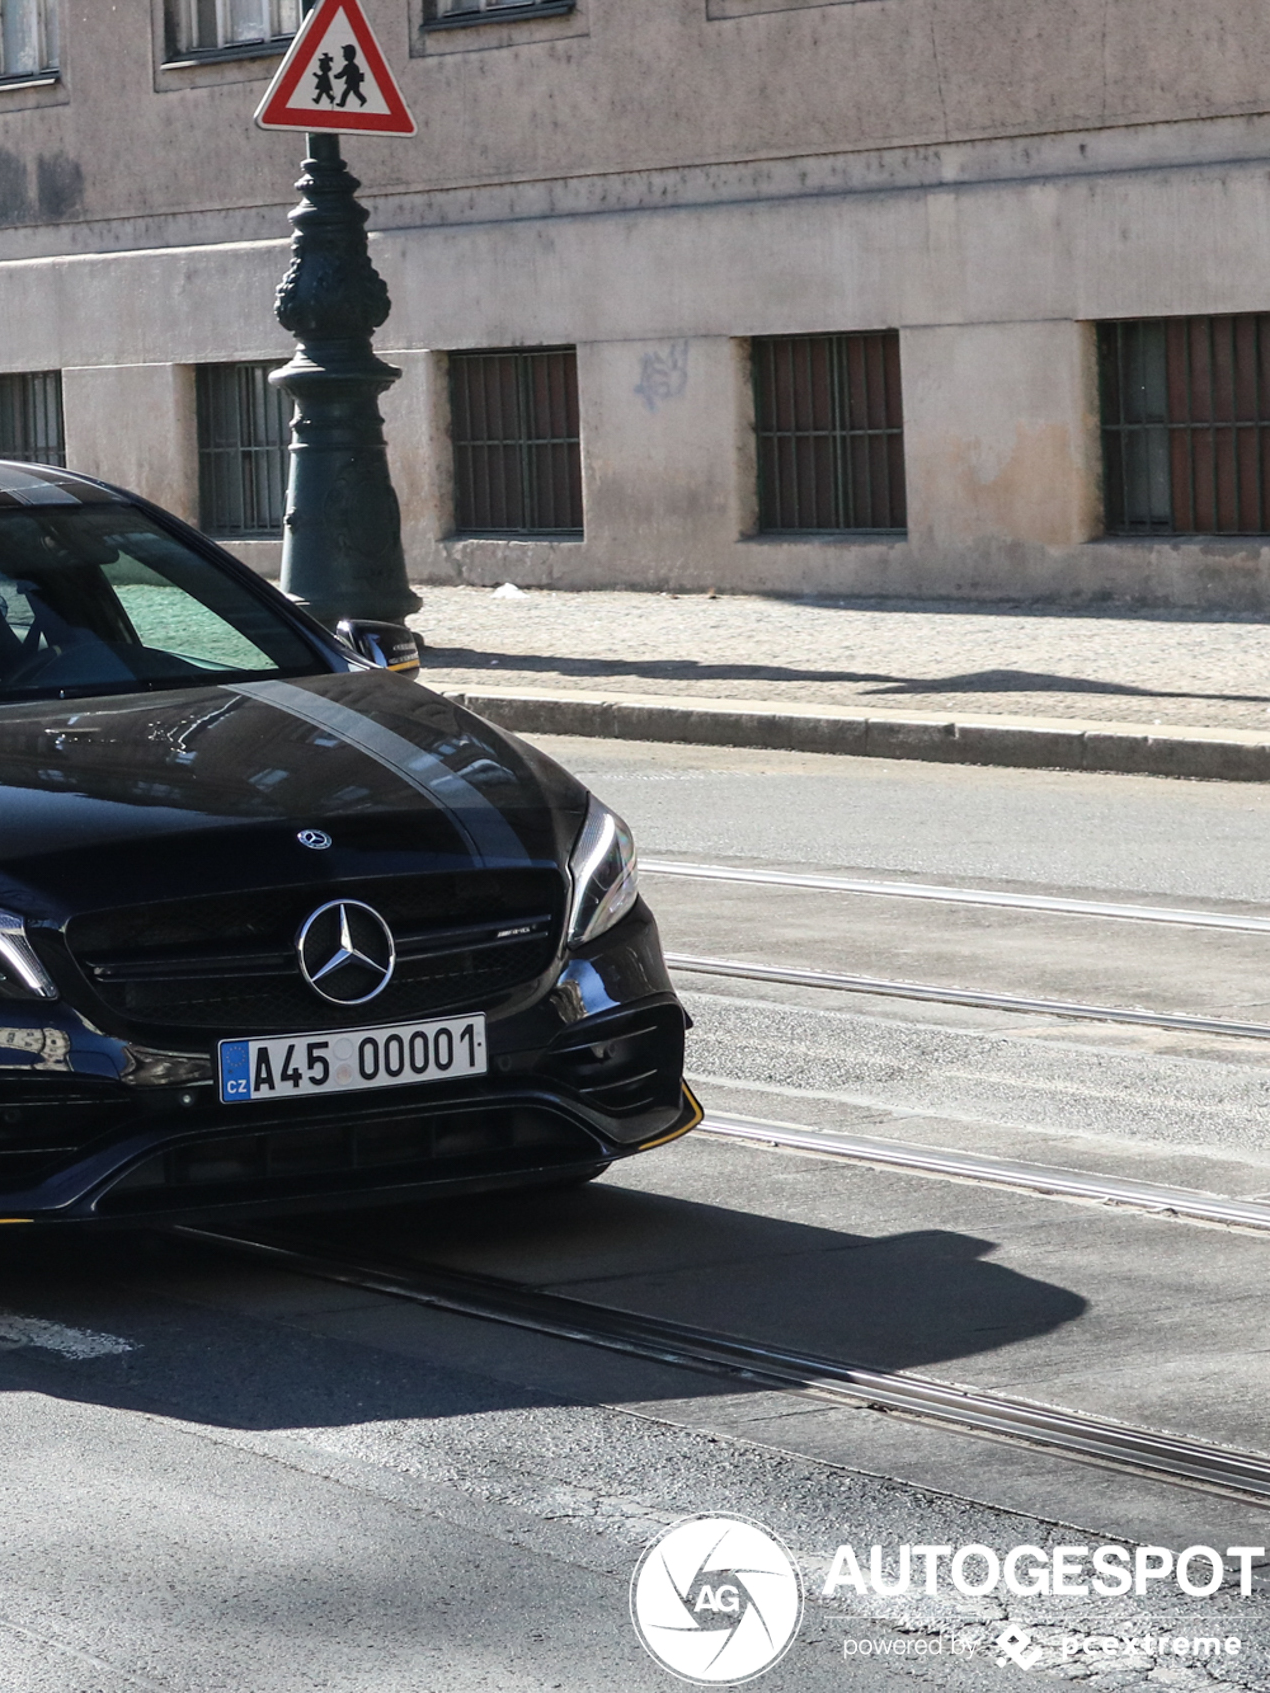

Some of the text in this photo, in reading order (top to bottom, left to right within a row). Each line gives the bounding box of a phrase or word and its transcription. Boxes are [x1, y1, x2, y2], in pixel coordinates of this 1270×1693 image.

[253, 1023, 476, 1092] A45 00001
[227, 1079, 247, 1094] CZ
